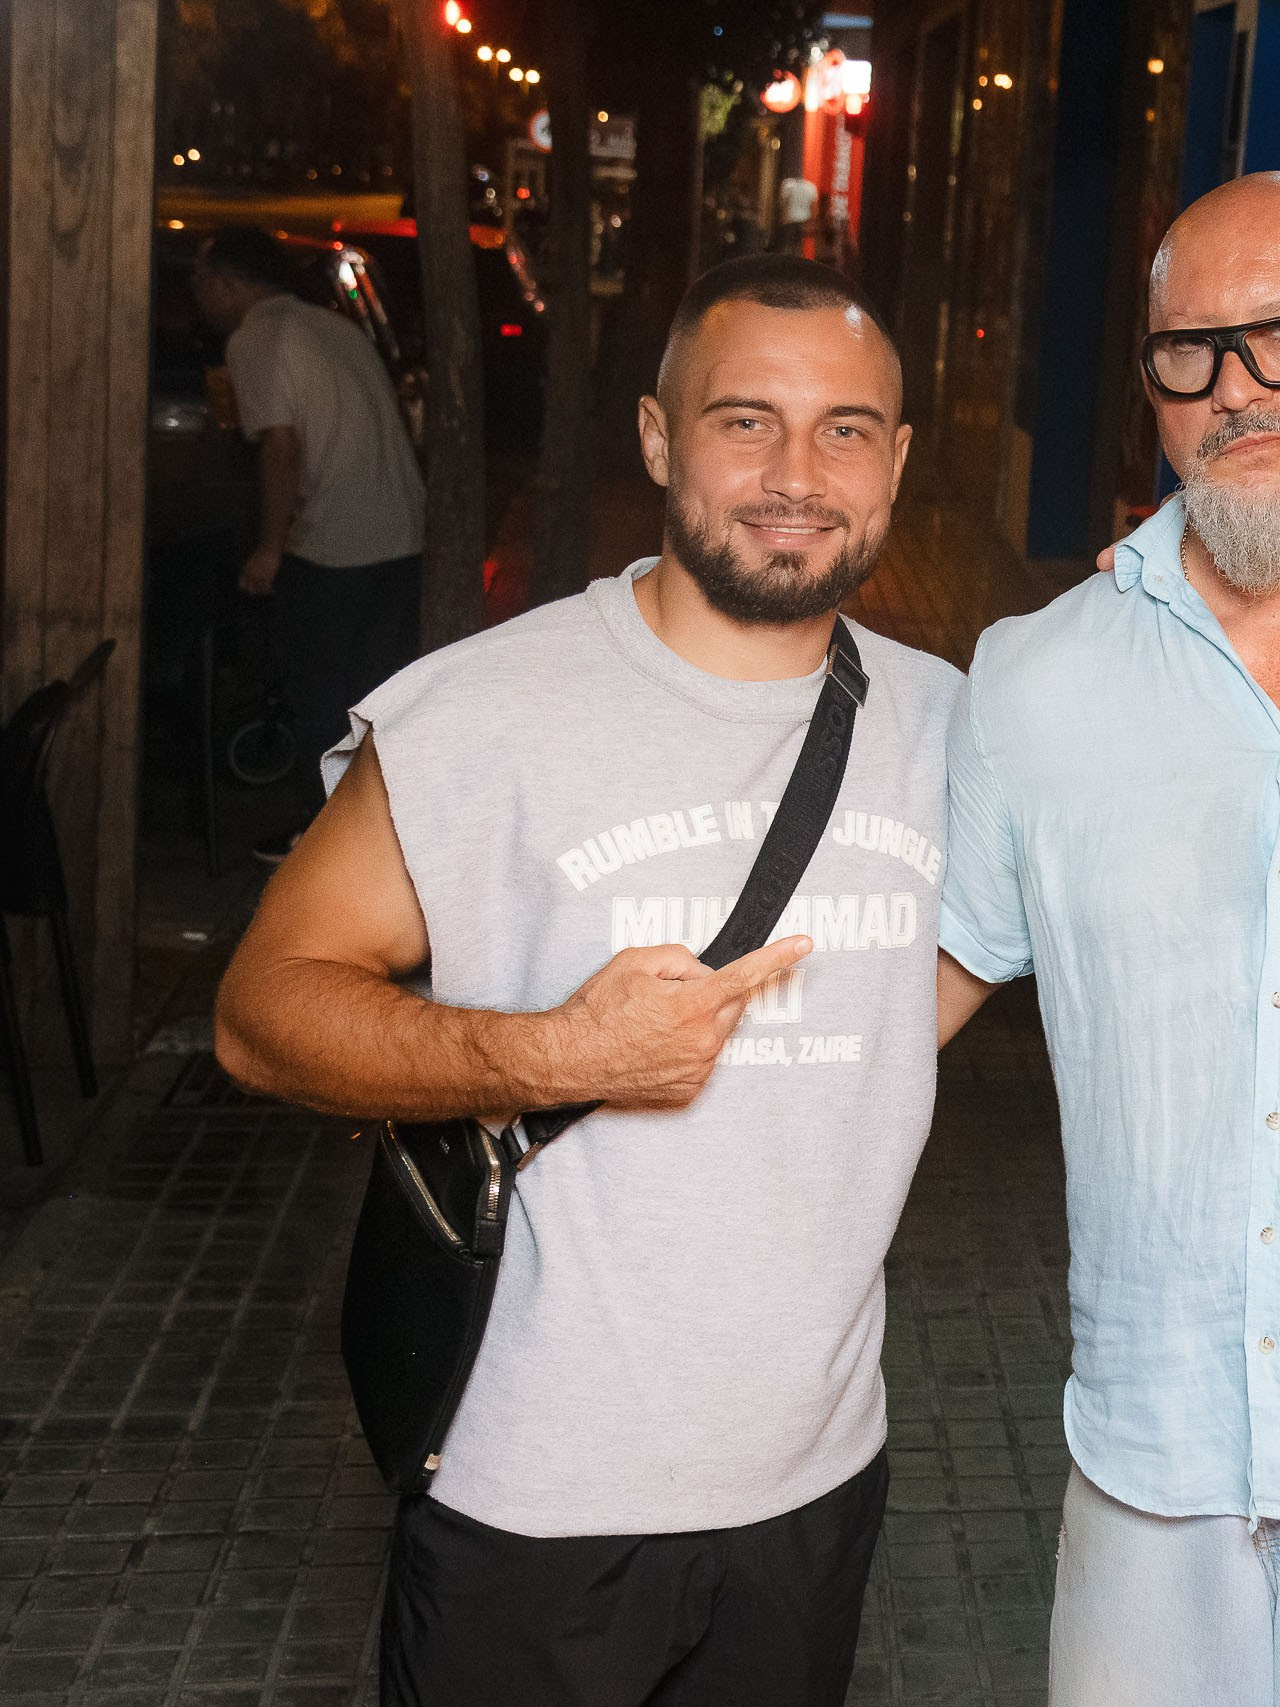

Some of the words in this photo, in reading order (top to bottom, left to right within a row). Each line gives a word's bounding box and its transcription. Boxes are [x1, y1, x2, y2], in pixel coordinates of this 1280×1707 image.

[557, 804, 721, 891] RUMBLE
[724, 801, 755, 840] IN
[832, 810, 942, 886] JUNGLE
[611, 892, 917, 957] MUHMMAD
[716, 1036, 793, 1068] HASA,
[798, 1034, 863, 1065] ZAIRE
